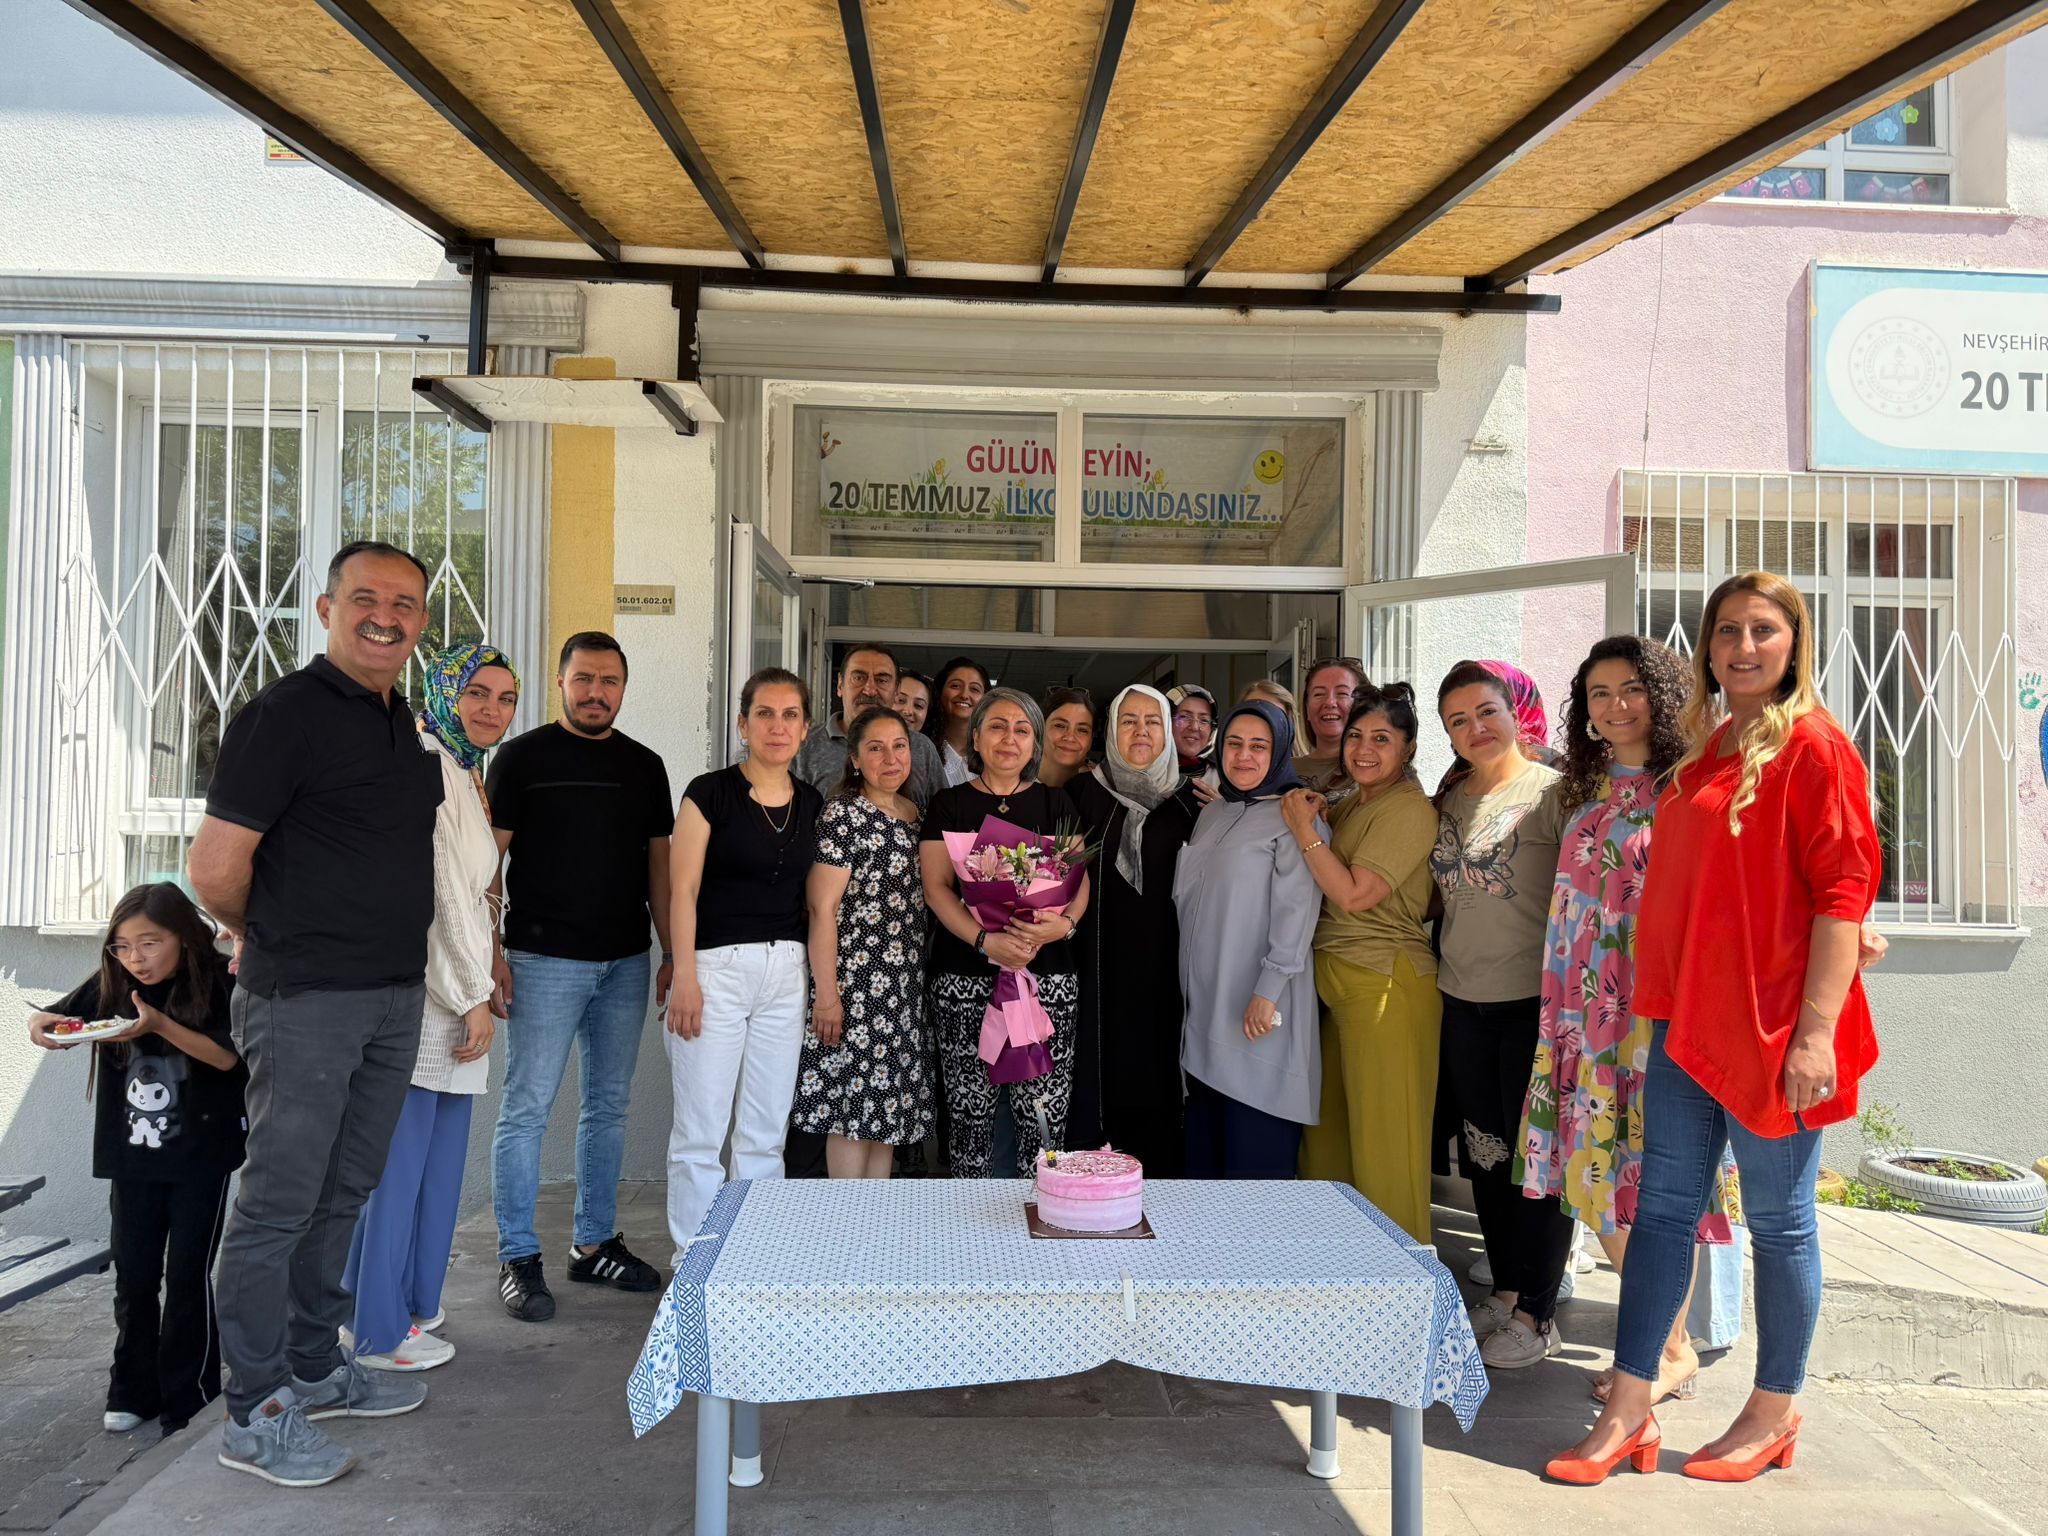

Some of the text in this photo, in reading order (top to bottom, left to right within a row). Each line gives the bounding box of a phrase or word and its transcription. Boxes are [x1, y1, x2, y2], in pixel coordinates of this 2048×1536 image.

[1963, 333, 2048, 353] NEVŞEHİR
[1960, 370, 2048, 412] 20 T
[829, 481, 861, 510] 20
[868, 482, 991, 513] TEMMUZ
[616, 596, 673, 605] 50.01.602.01
